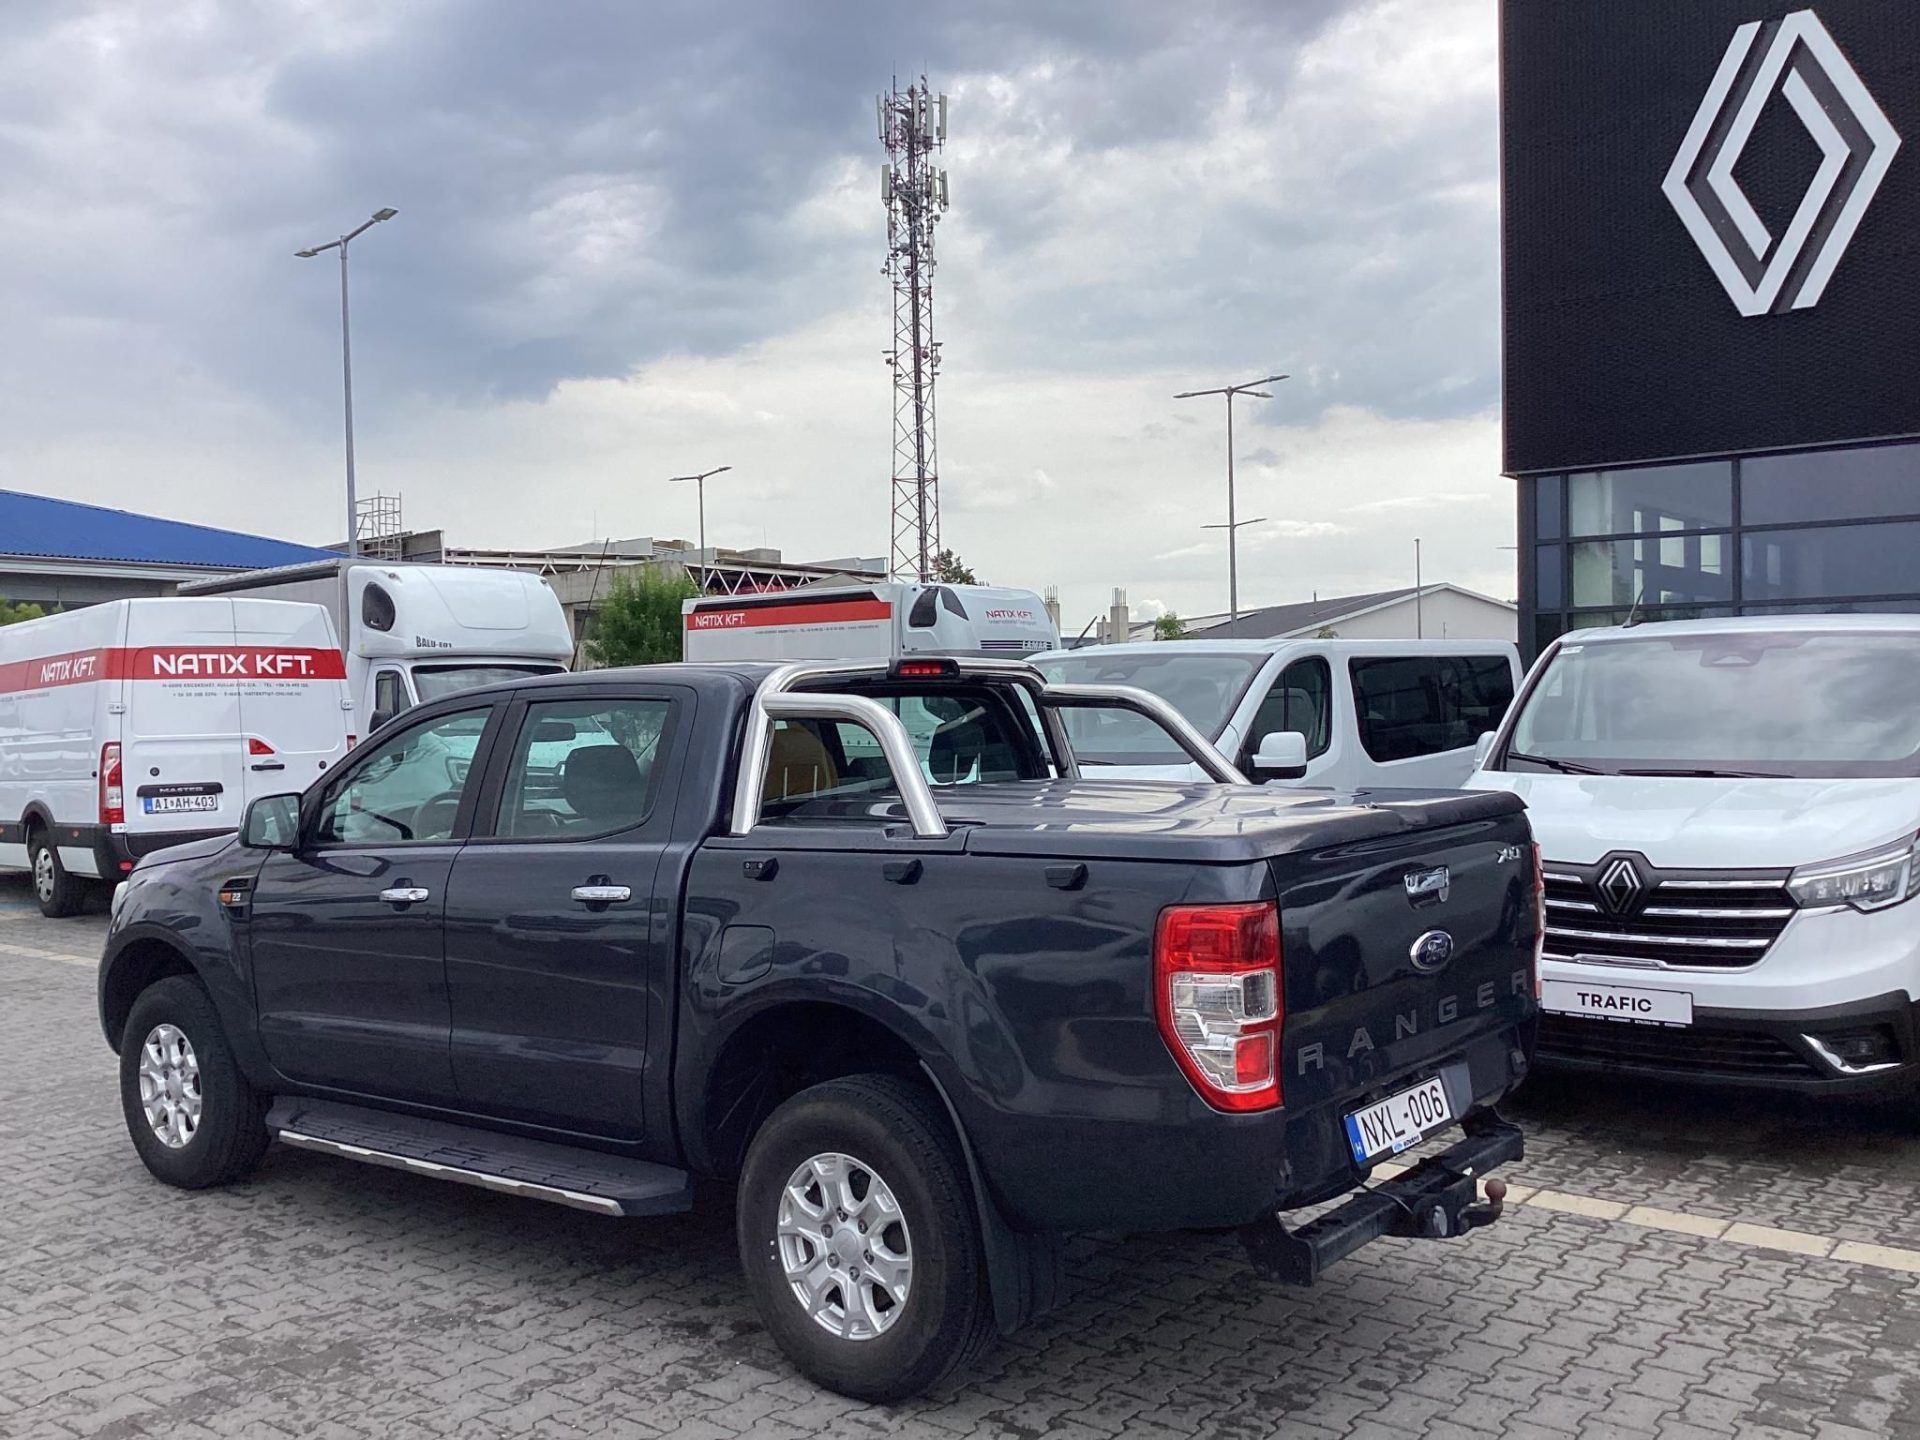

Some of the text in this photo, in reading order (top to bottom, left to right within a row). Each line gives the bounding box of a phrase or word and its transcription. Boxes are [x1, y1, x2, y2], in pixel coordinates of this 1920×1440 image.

[695, 612, 746, 628] NATIX KFT.
[985, 610, 1016, 618] NATIX
[40, 656, 97, 684] NATIX KFT.
[152, 653, 315, 675] NATIX KFT.
[1577, 992, 1653, 1013] TRAFIC
[1297, 968, 1528, 1077] RANGER
[1360, 1085, 1445, 1152] NXL-006
